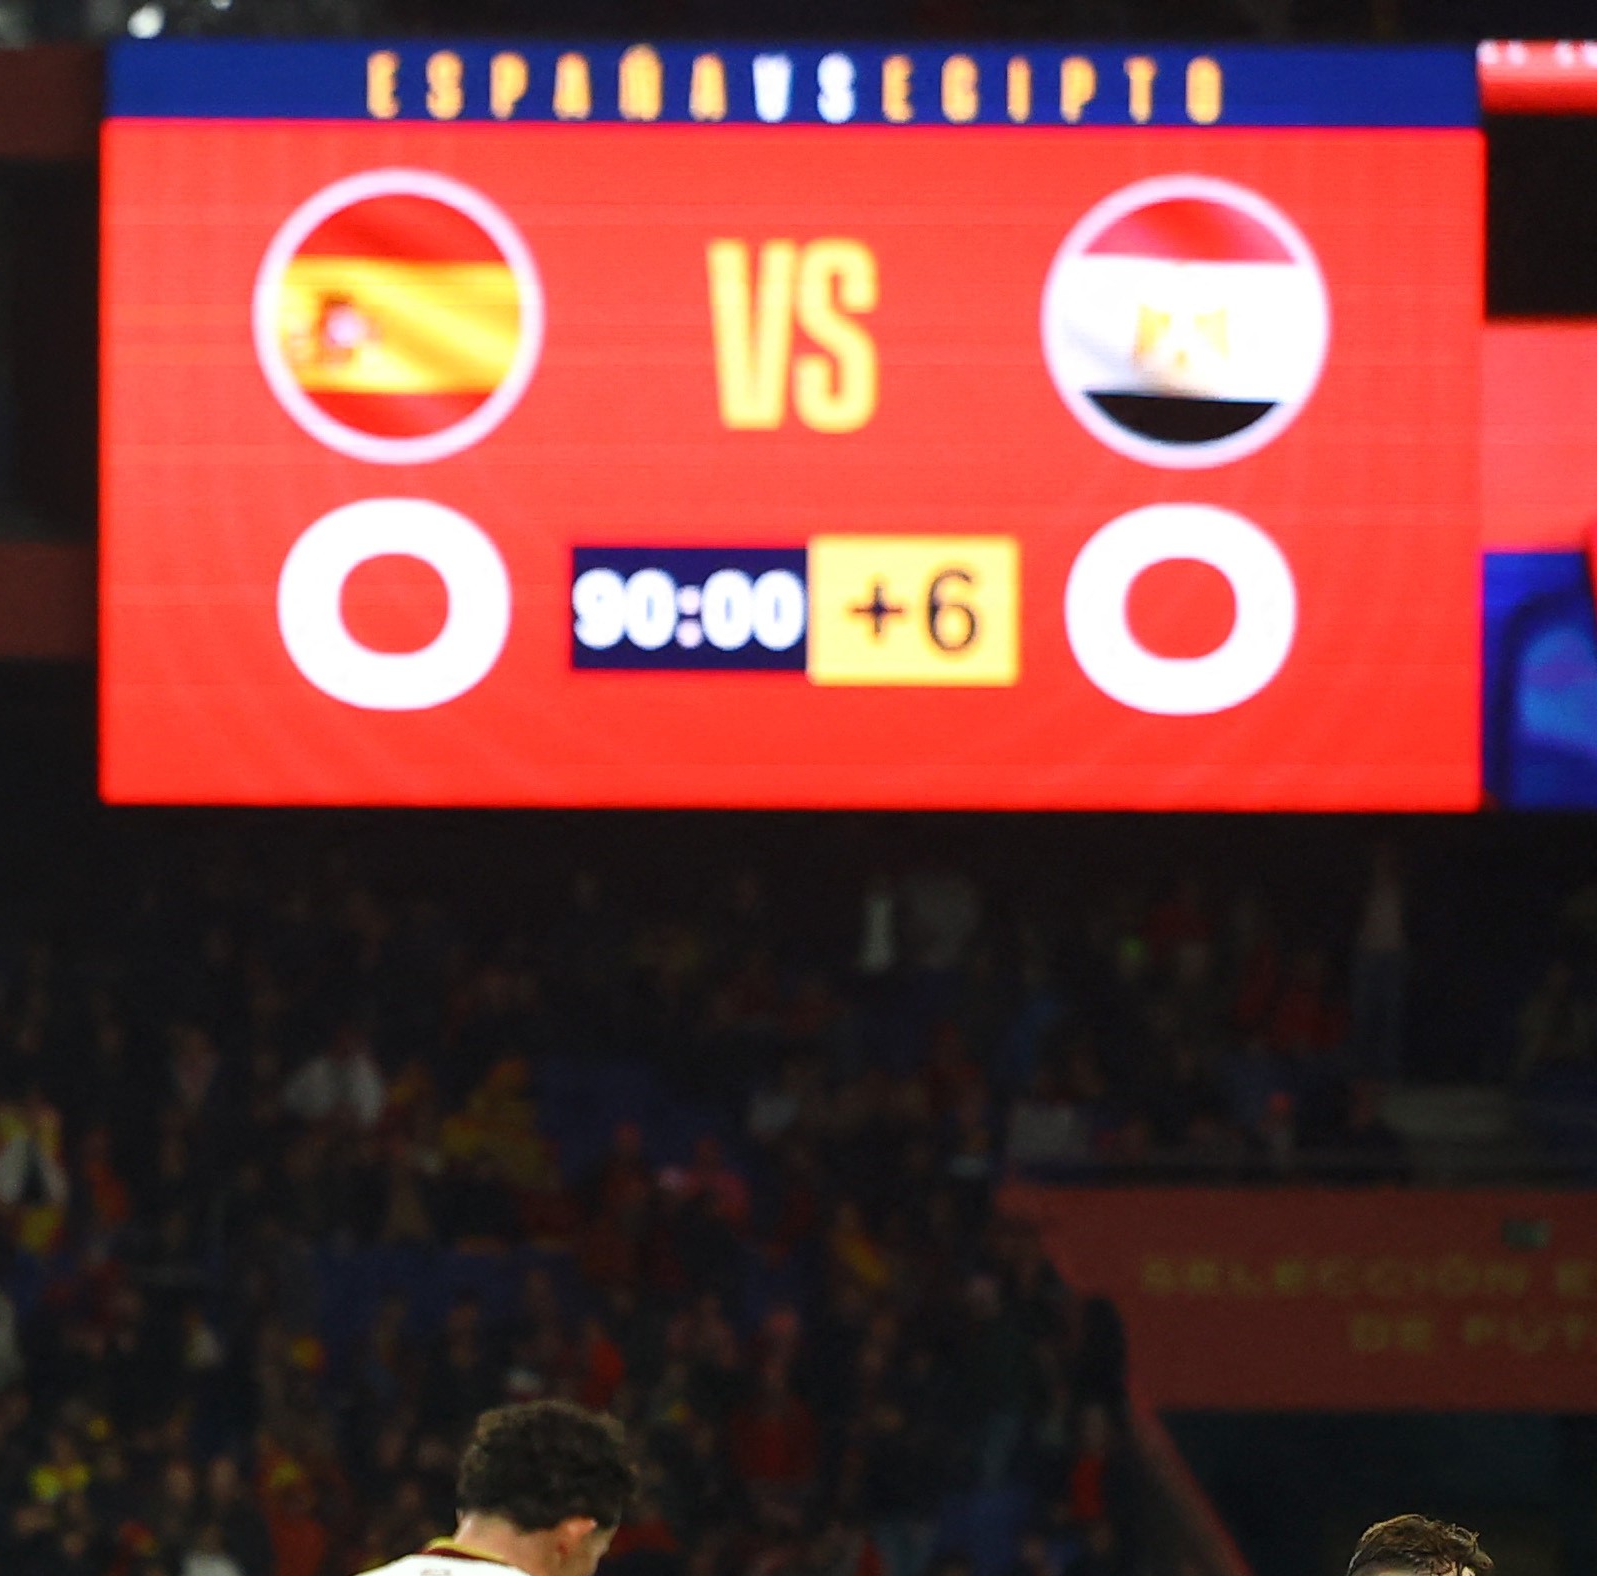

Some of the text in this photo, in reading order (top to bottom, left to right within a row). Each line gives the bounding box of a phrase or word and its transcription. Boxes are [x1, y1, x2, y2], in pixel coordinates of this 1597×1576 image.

[366, 43, 728, 122] ESPAÑA
[881, 53, 1223, 126] EGIPTO
[705, 241, 878, 432] VS
[571, 567, 807, 651] 90:00
[853, 568, 977, 653] +6
